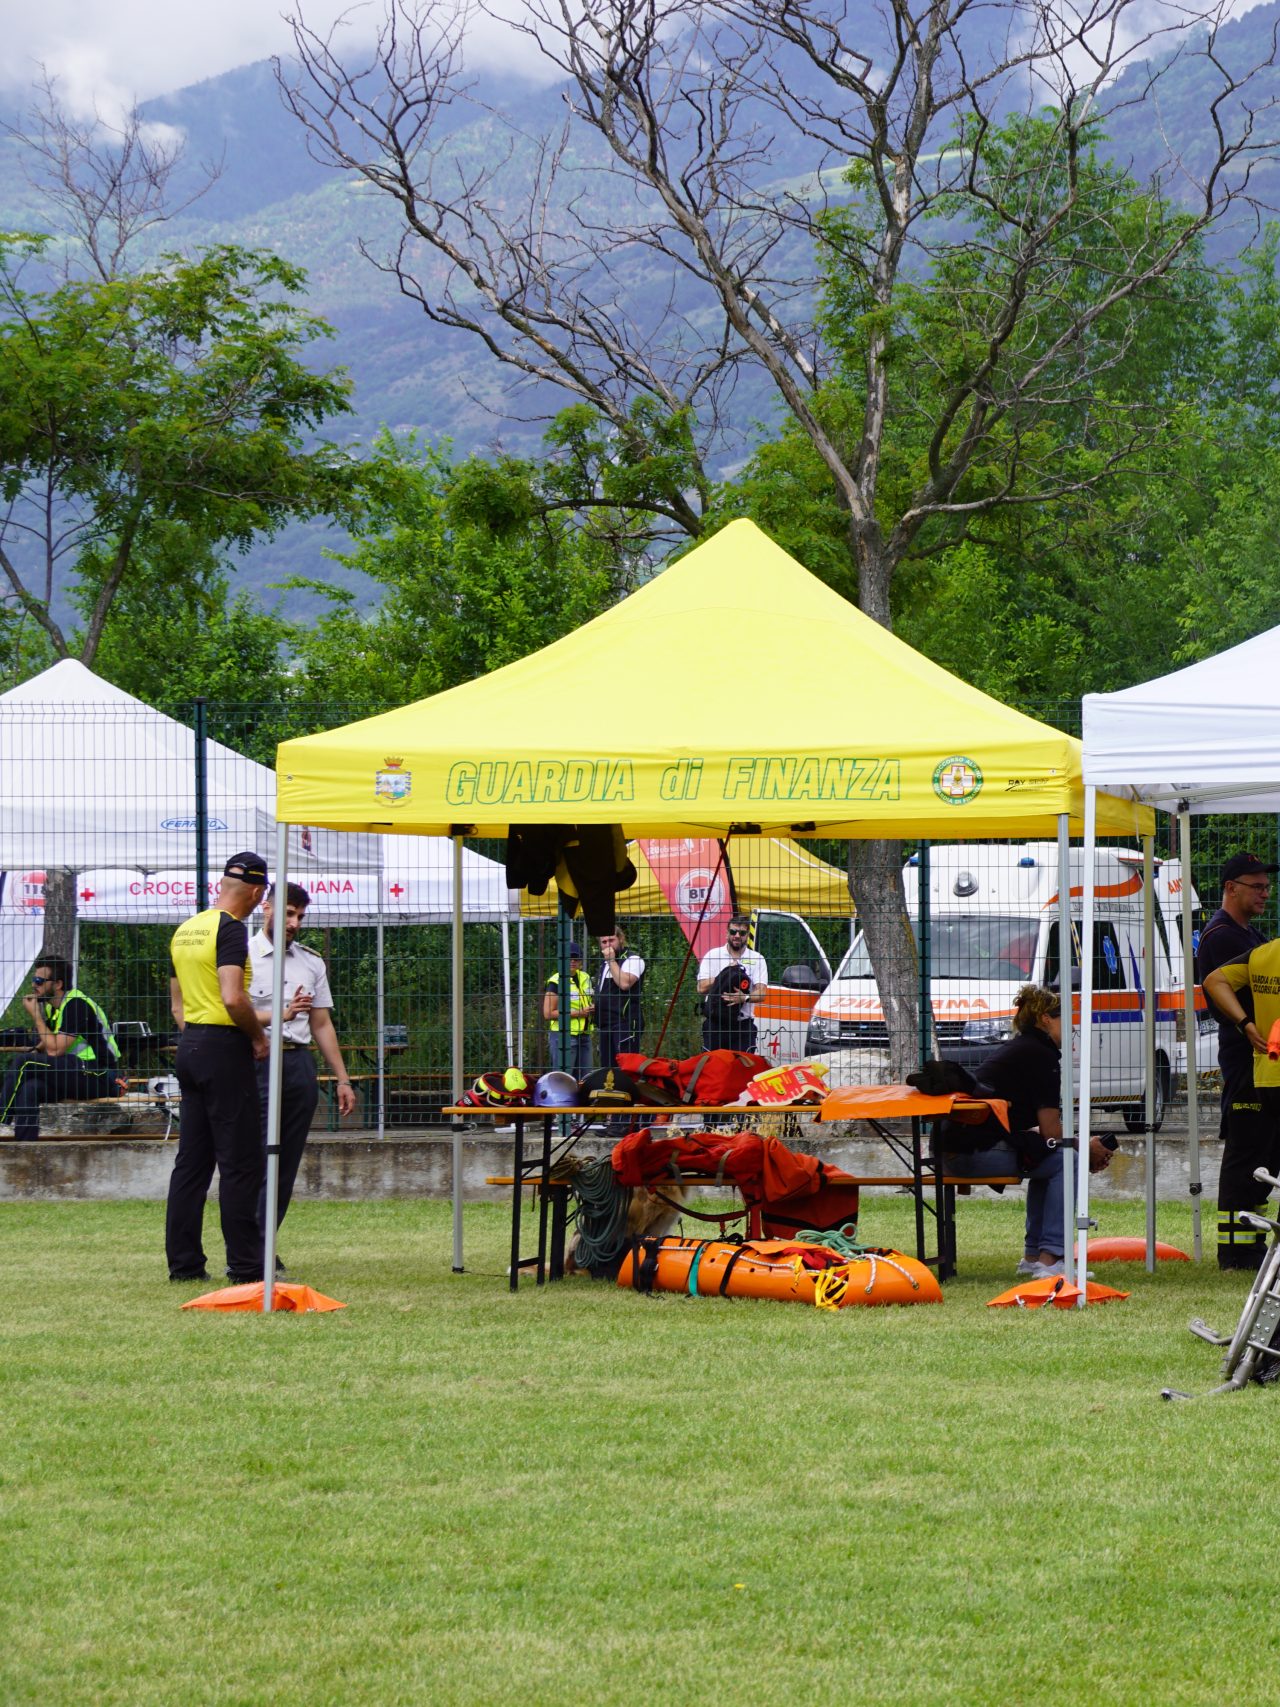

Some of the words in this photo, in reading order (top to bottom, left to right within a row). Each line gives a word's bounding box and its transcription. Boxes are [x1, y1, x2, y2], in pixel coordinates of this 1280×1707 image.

[446, 760, 635, 806] GUARDIA
[659, 758, 704, 800] di
[723, 758, 900, 800] FINANZA
[129, 882, 194, 895] CROCE
